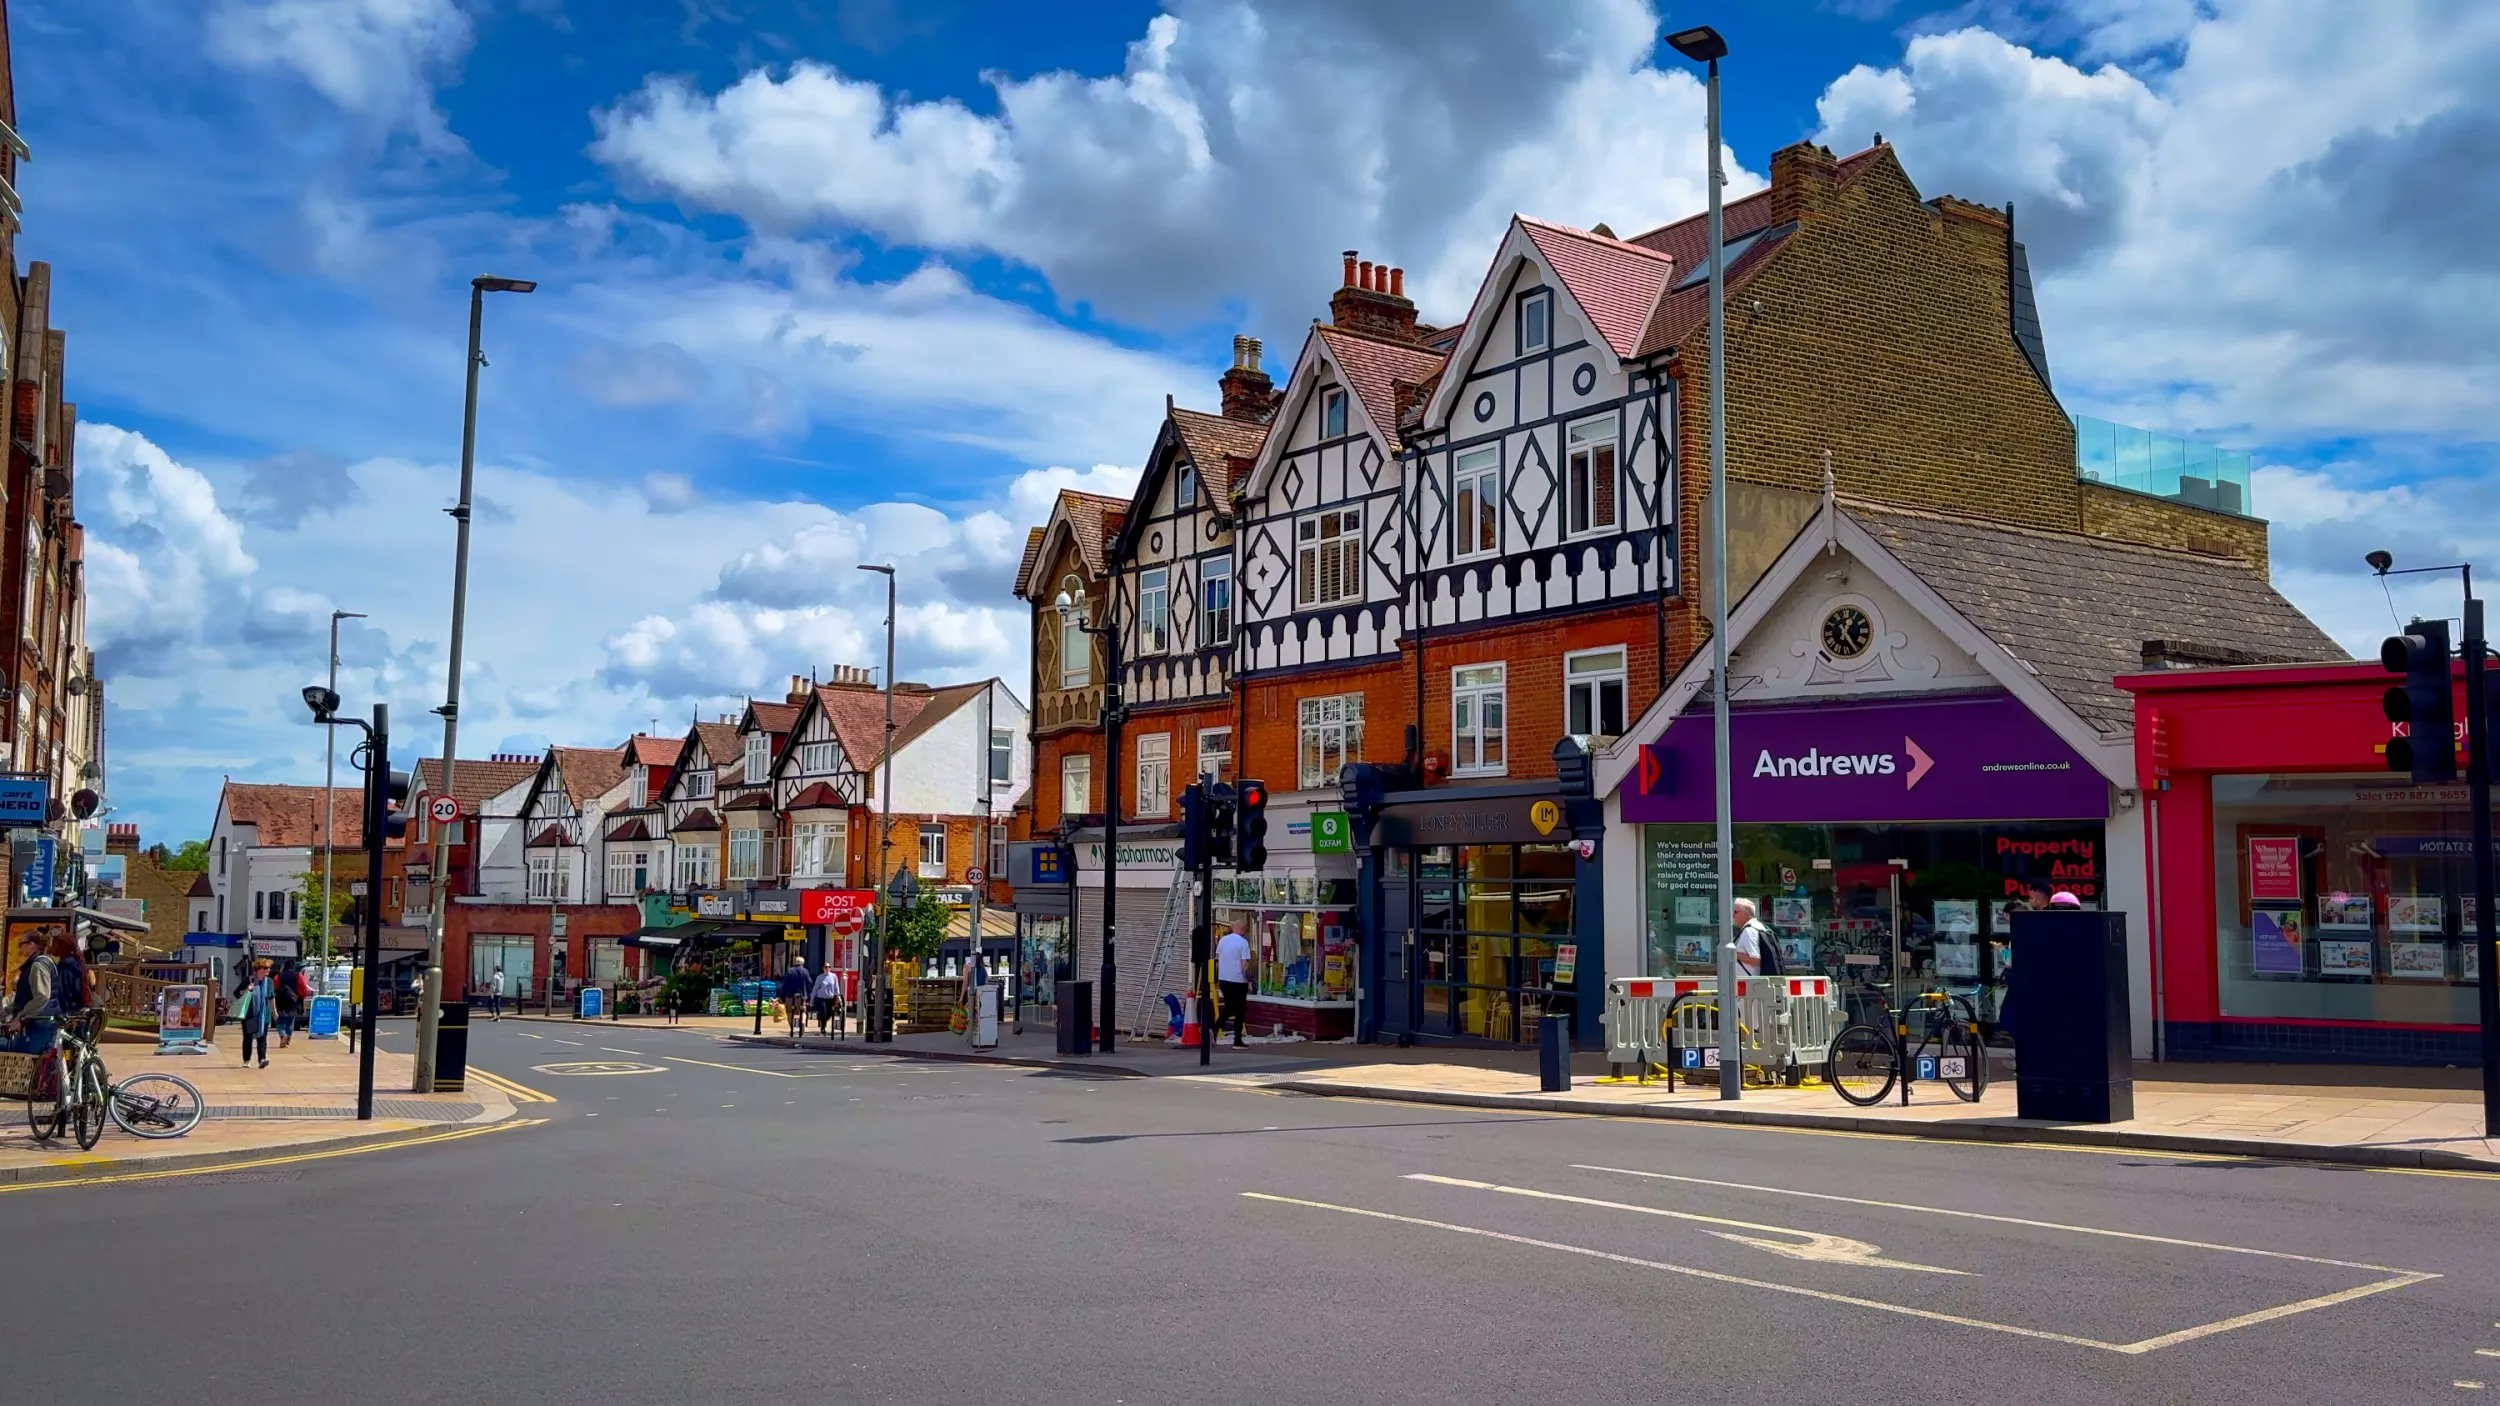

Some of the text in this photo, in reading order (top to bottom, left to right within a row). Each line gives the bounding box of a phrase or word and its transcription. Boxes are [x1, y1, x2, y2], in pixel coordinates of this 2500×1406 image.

[1753, 748, 1896, 778] Andrews
[1983, 761, 2071, 772] andrewsonline.co.uk
[2356, 790, 2467, 801] Sales 020 8871 9655
[434, 803, 456, 815] 20
[1319, 839, 1342, 848] OXFAM
[1680, 841, 1703, 849] found
[1996, 836, 2093, 859] Property
[1097, 844, 1175, 868] Mdipharmacy
[1678, 862, 1711, 870] together
[2051, 859, 2095, 877] And
[969, 871, 983, 880] 20
[1657, 872, 1683, 880] raising
[1669, 882, 1689, 890] good
[2004, 879, 2095, 897] Puose
[824, 895, 857, 907] POST
[1686, 1051, 1698, 1066] P
[1921, 1060, 1933, 1078] P
